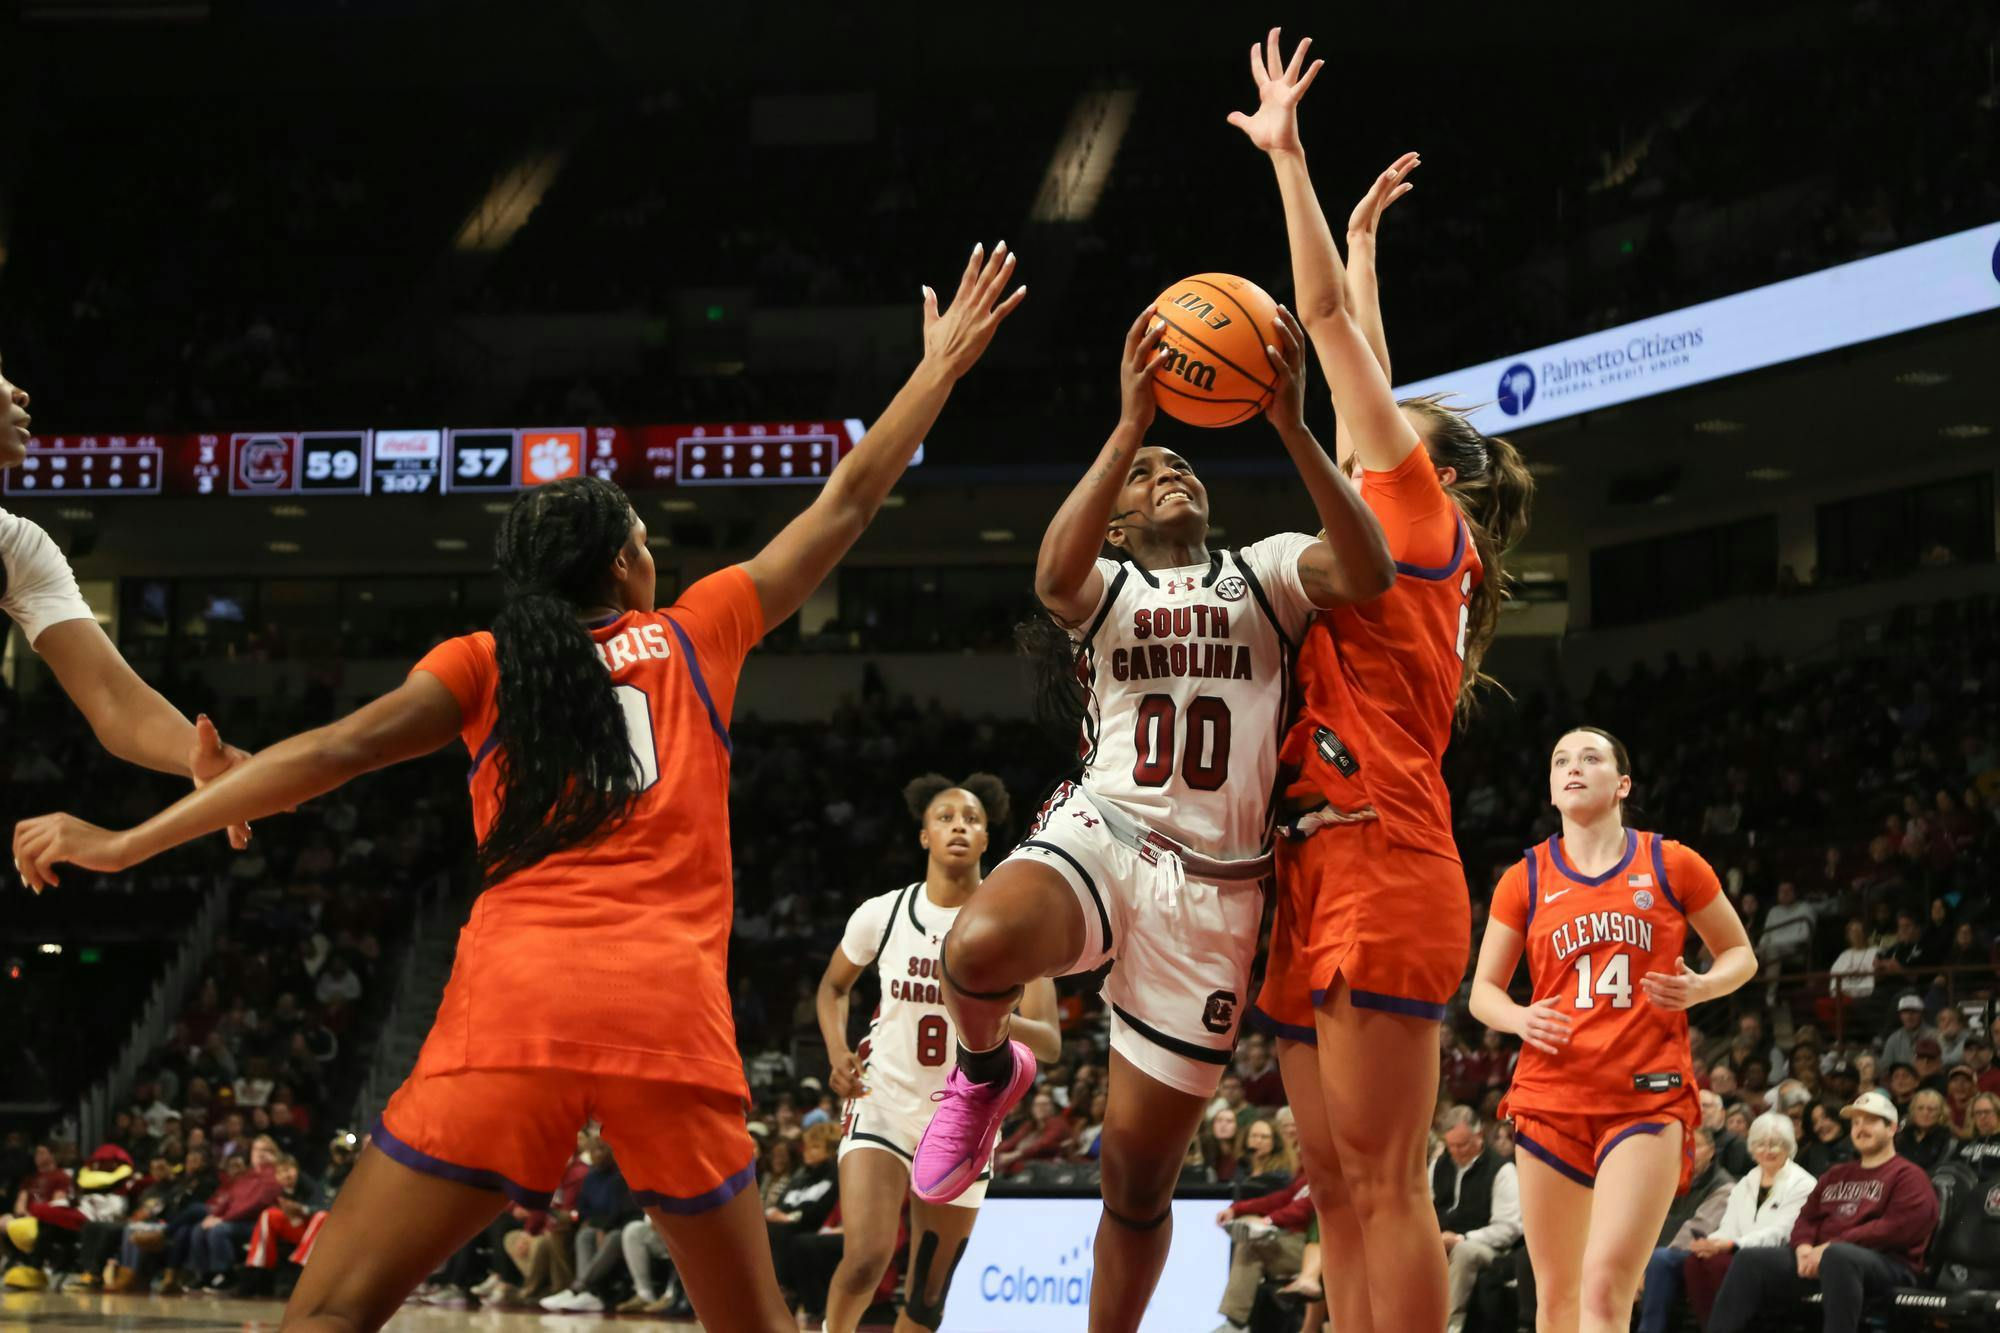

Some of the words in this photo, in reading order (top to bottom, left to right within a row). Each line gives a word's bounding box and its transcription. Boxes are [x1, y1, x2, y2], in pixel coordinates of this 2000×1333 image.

[1542, 348, 1625, 385] Palmetto
[1626, 327, 1704, 363] Citizens
[1542, 381, 1594, 399] FEDERAL
[1600, 366, 1644, 384] CREDIT
[1651, 354, 1690, 371] UNION
[307, 451, 358, 480] 59
[457, 448, 509, 477] 37
[382, 474, 431, 493] 3:07
[1134, 605, 1229, 639] SOUTH
[1112, 643, 1252, 681] CAROLINA
[1133, 694, 1231, 791] 00
[1552, 911, 1652, 960] CLEMSON
[908, 957, 941, 980] SOU
[1575, 954, 1632, 1008] 14
[891, 979, 945, 1005] CAROL
[917, 1014, 948, 1066] 8
[981, 1264, 1091, 1305] Colonial
